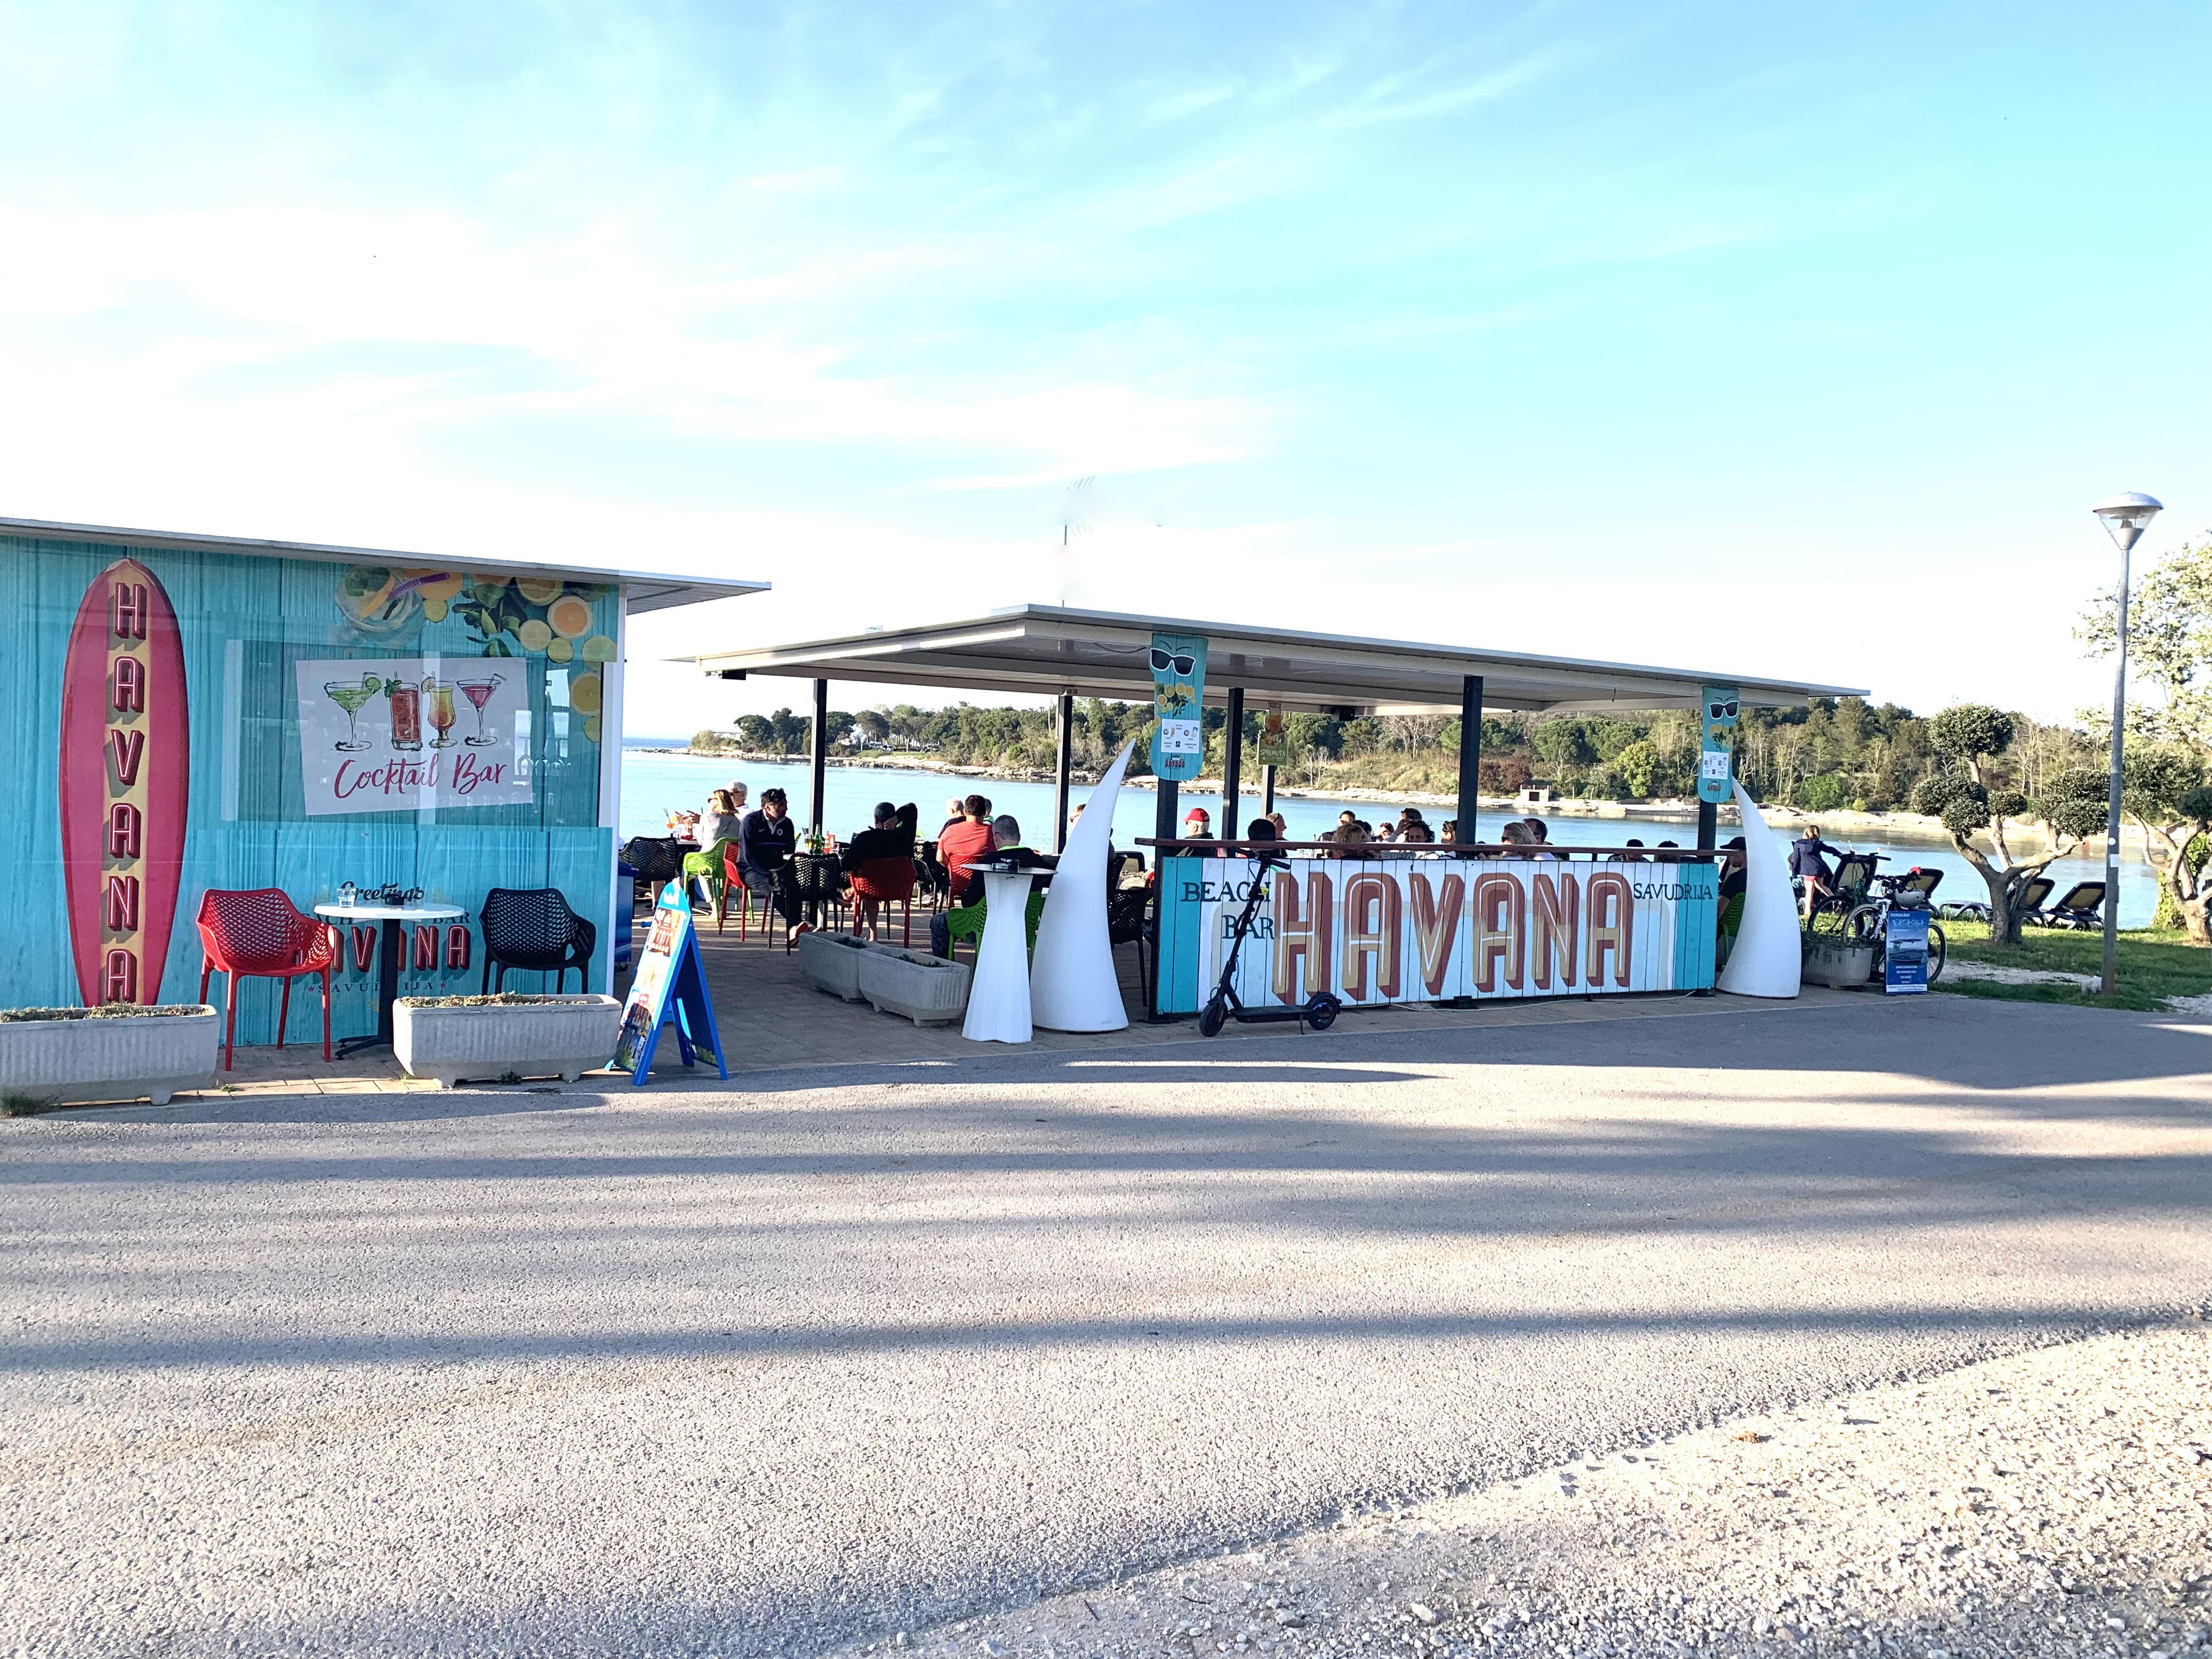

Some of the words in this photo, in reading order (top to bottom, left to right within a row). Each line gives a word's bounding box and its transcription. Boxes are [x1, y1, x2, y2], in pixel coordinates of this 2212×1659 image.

[106, 582, 148, 1003] HAVANA
[334, 753, 439, 798] Cocktail
[452, 752, 507, 794] Bar
[1633, 883, 1713, 900] SAVUDRIJA
[1222, 915, 1274, 939] BAR
[1272, 872, 1634, 1005] HAVANA
[318, 981, 433, 993] SAVUIJA
